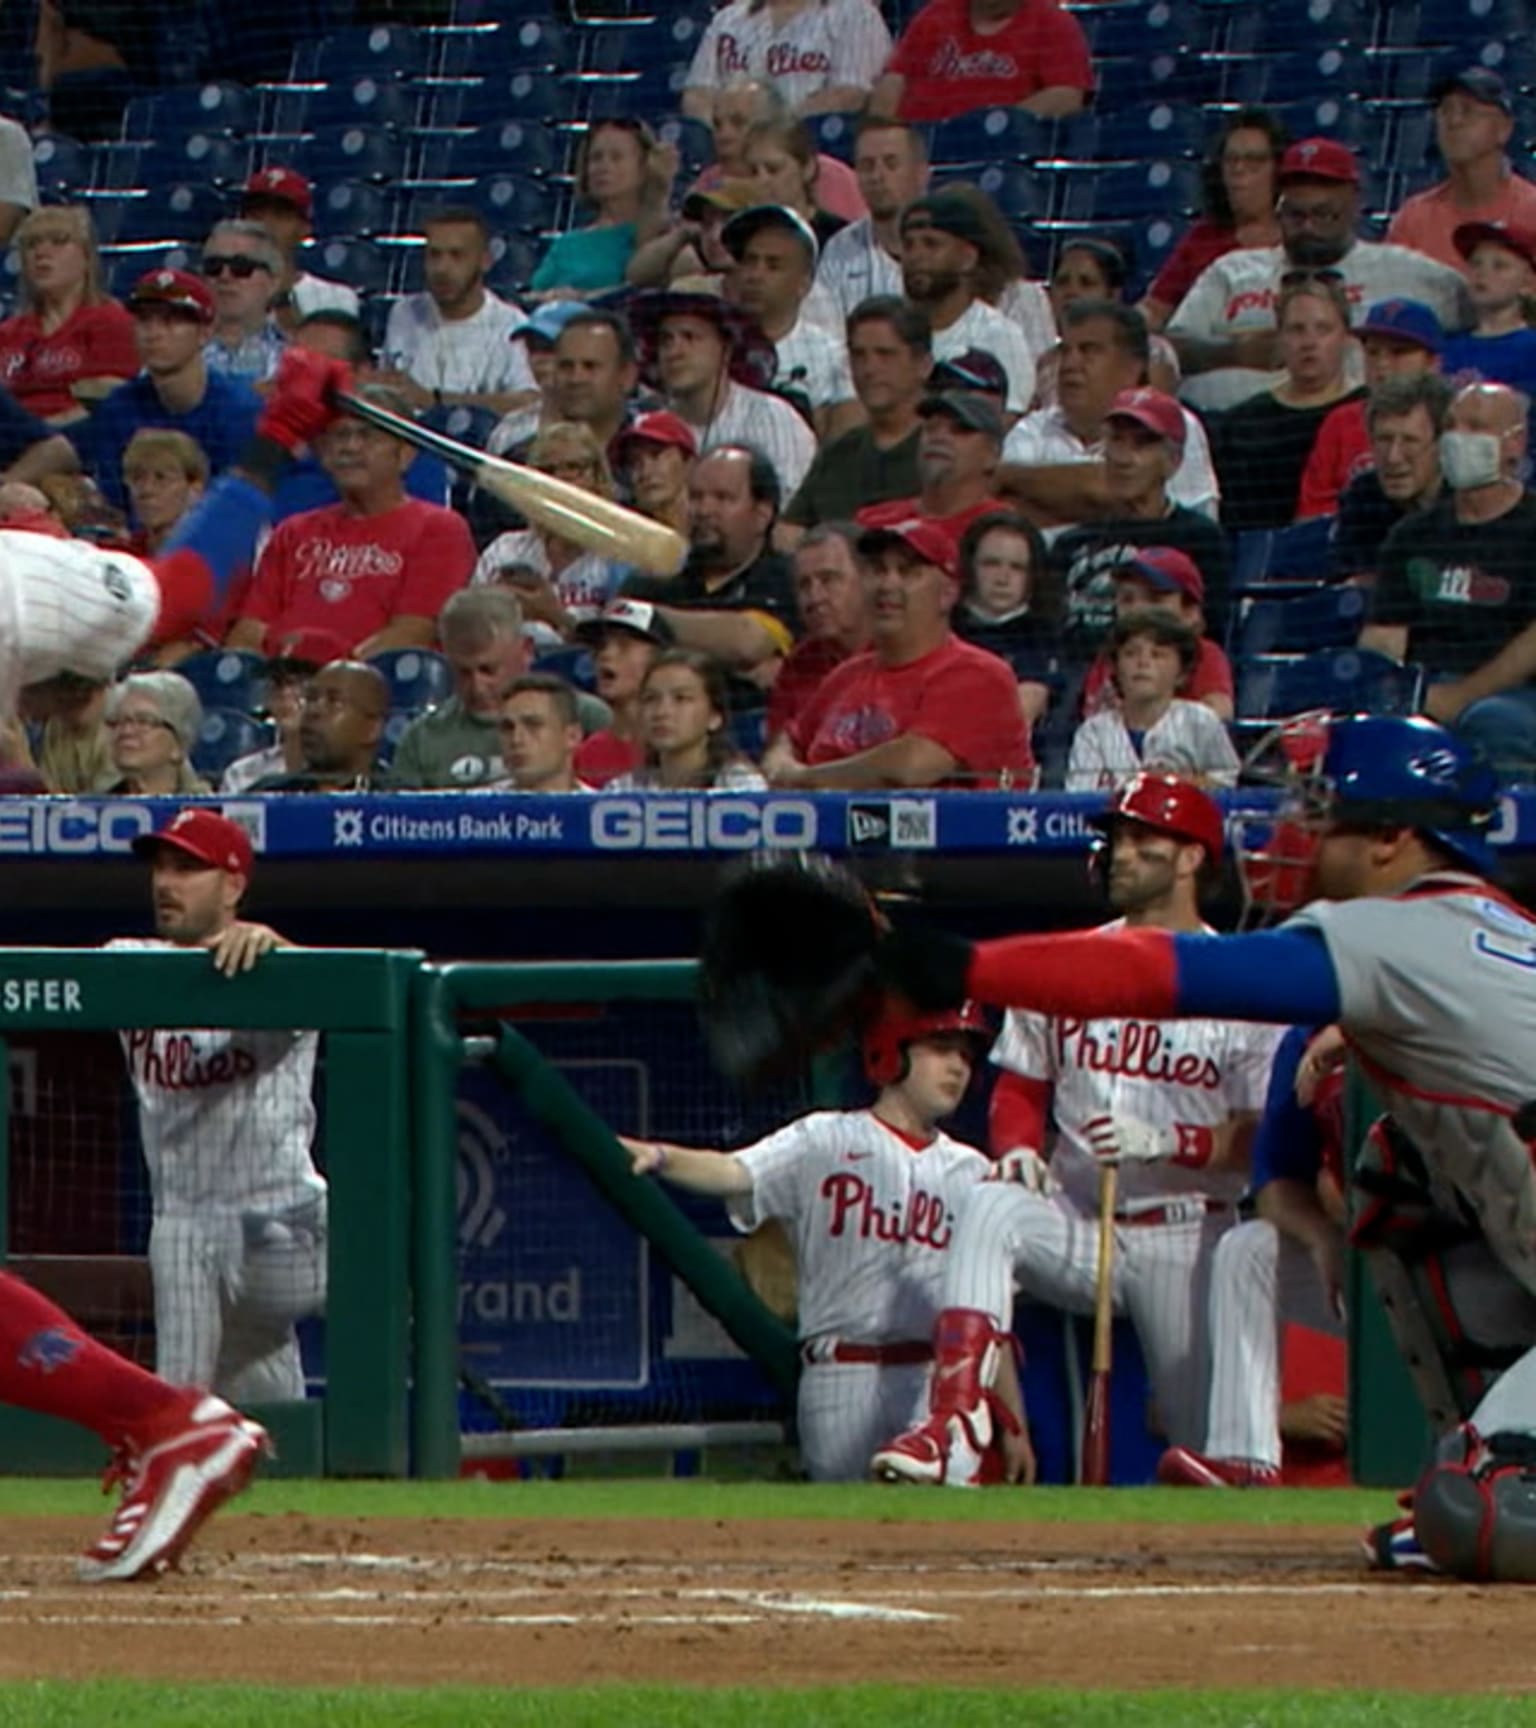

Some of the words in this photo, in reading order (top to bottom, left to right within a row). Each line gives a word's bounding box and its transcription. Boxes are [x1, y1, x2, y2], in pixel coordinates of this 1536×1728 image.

[369, 815, 456, 841] Citizens
[458, 814, 511, 840] Bank
[515, 813, 563, 839] Park
[590, 798, 818, 849] GEICO
[1057, 1017, 1222, 1090] Phillies
[821, 1170, 955, 1250] Philli
